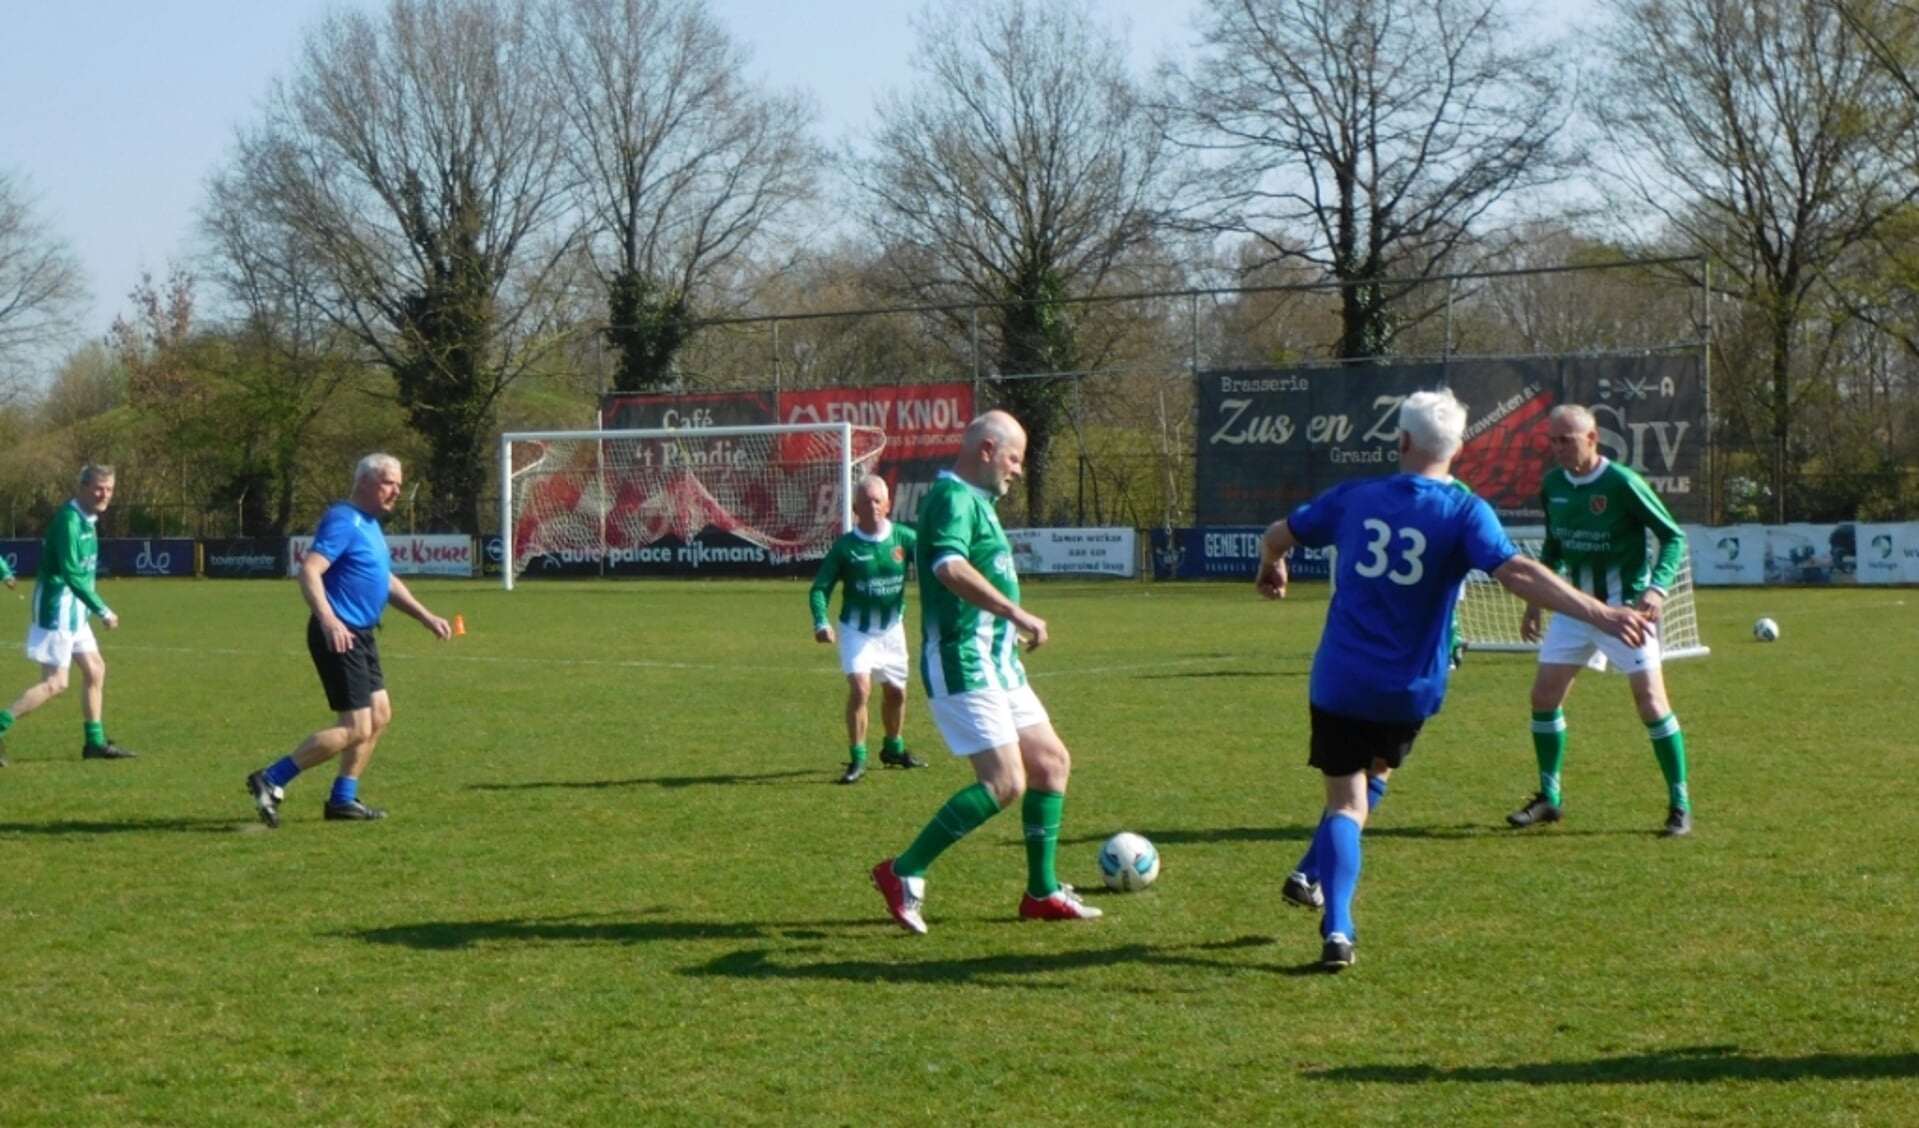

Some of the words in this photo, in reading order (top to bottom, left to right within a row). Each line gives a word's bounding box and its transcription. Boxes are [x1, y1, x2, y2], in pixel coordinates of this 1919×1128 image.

[1221, 376, 1309, 392] Brasserie
[661, 408, 713, 429] Café
[827, 402, 890, 430] EDDY
[897, 398, 966, 430] KNOL
[1210, 399, 1295, 444] Zus
[1306, 414, 1354, 442] en
[1329, 447, 1383, 463] Grand
[610, 545, 671, 567] palace
[678, 541, 764, 568] rijkmans
[1205, 533, 1264, 558] GENIETEN
[1354, 518, 1427, 586] 33
